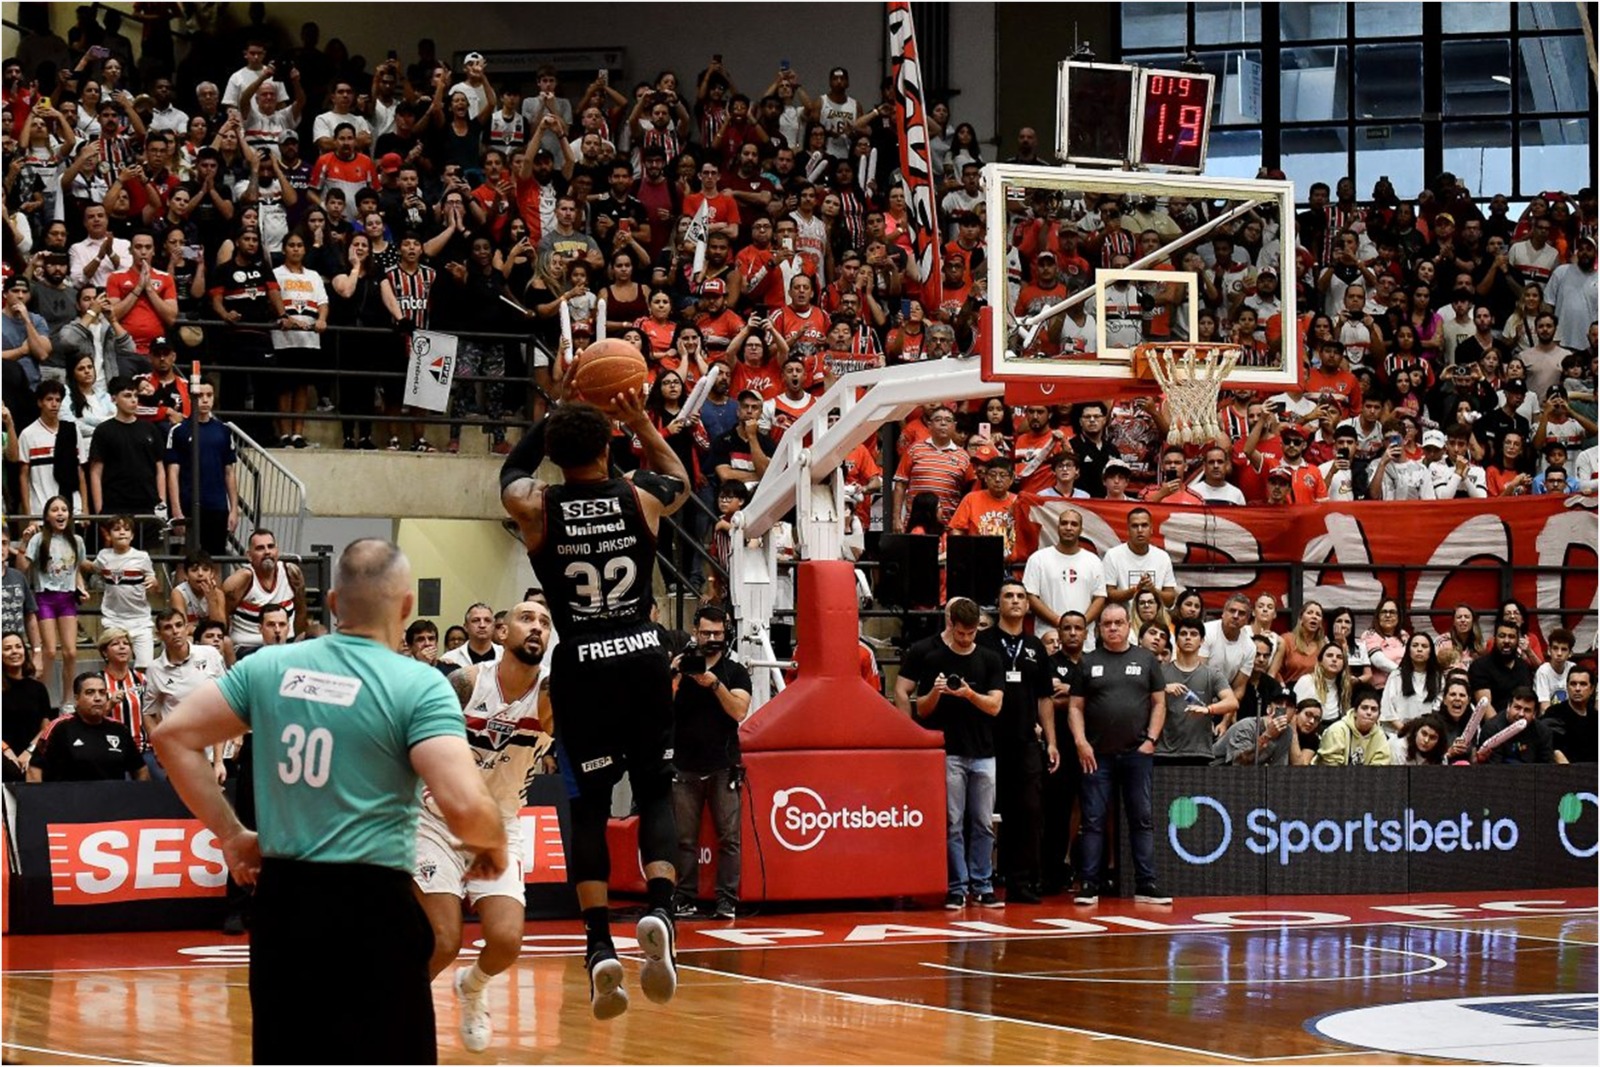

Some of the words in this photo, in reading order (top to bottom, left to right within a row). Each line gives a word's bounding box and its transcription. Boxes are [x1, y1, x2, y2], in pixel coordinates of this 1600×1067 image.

[1157, 103, 1203, 146] 1.9
[567, 500, 619, 518] SESI
[565, 518, 626, 537] Unimed
[557, 542, 592, 555] DAVID
[595, 535, 638, 554] JAKSON
[564, 555, 640, 614] 32
[577, 629, 661, 663] FREEWAY
[278, 723, 334, 788] 30
[784, 804, 924, 836] Sportsbet.io
[1244, 807, 1520, 866] Sportsbet.io
